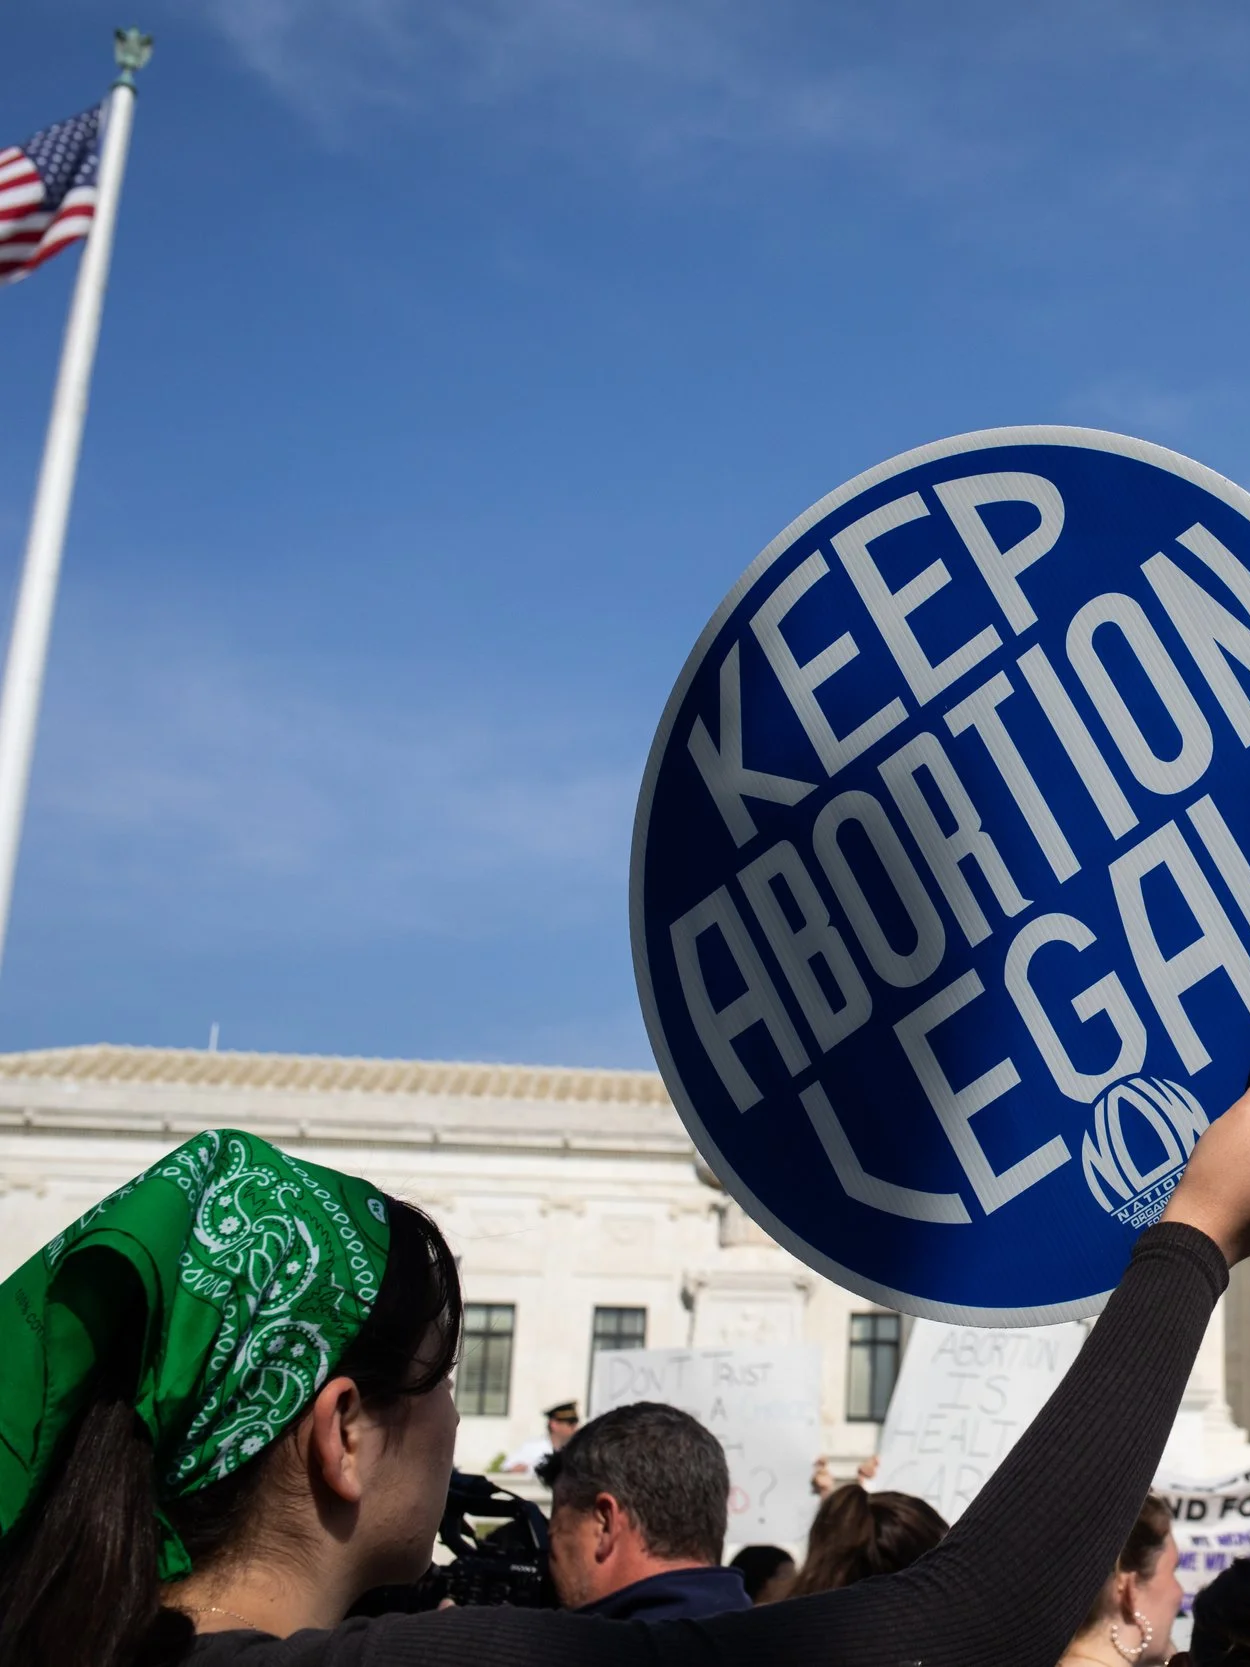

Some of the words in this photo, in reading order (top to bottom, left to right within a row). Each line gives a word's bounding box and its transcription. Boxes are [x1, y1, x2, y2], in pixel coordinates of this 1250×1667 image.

[687, 471, 1065, 848] KEEP
[1081, 1076, 1211, 1213] NOW
[930, 1328, 1060, 1373] ABORTION
[937, 1371, 1011, 1415] IS
[888, 1407, 1019, 1458] HEALT
[883, 1461, 992, 1519] CAR
